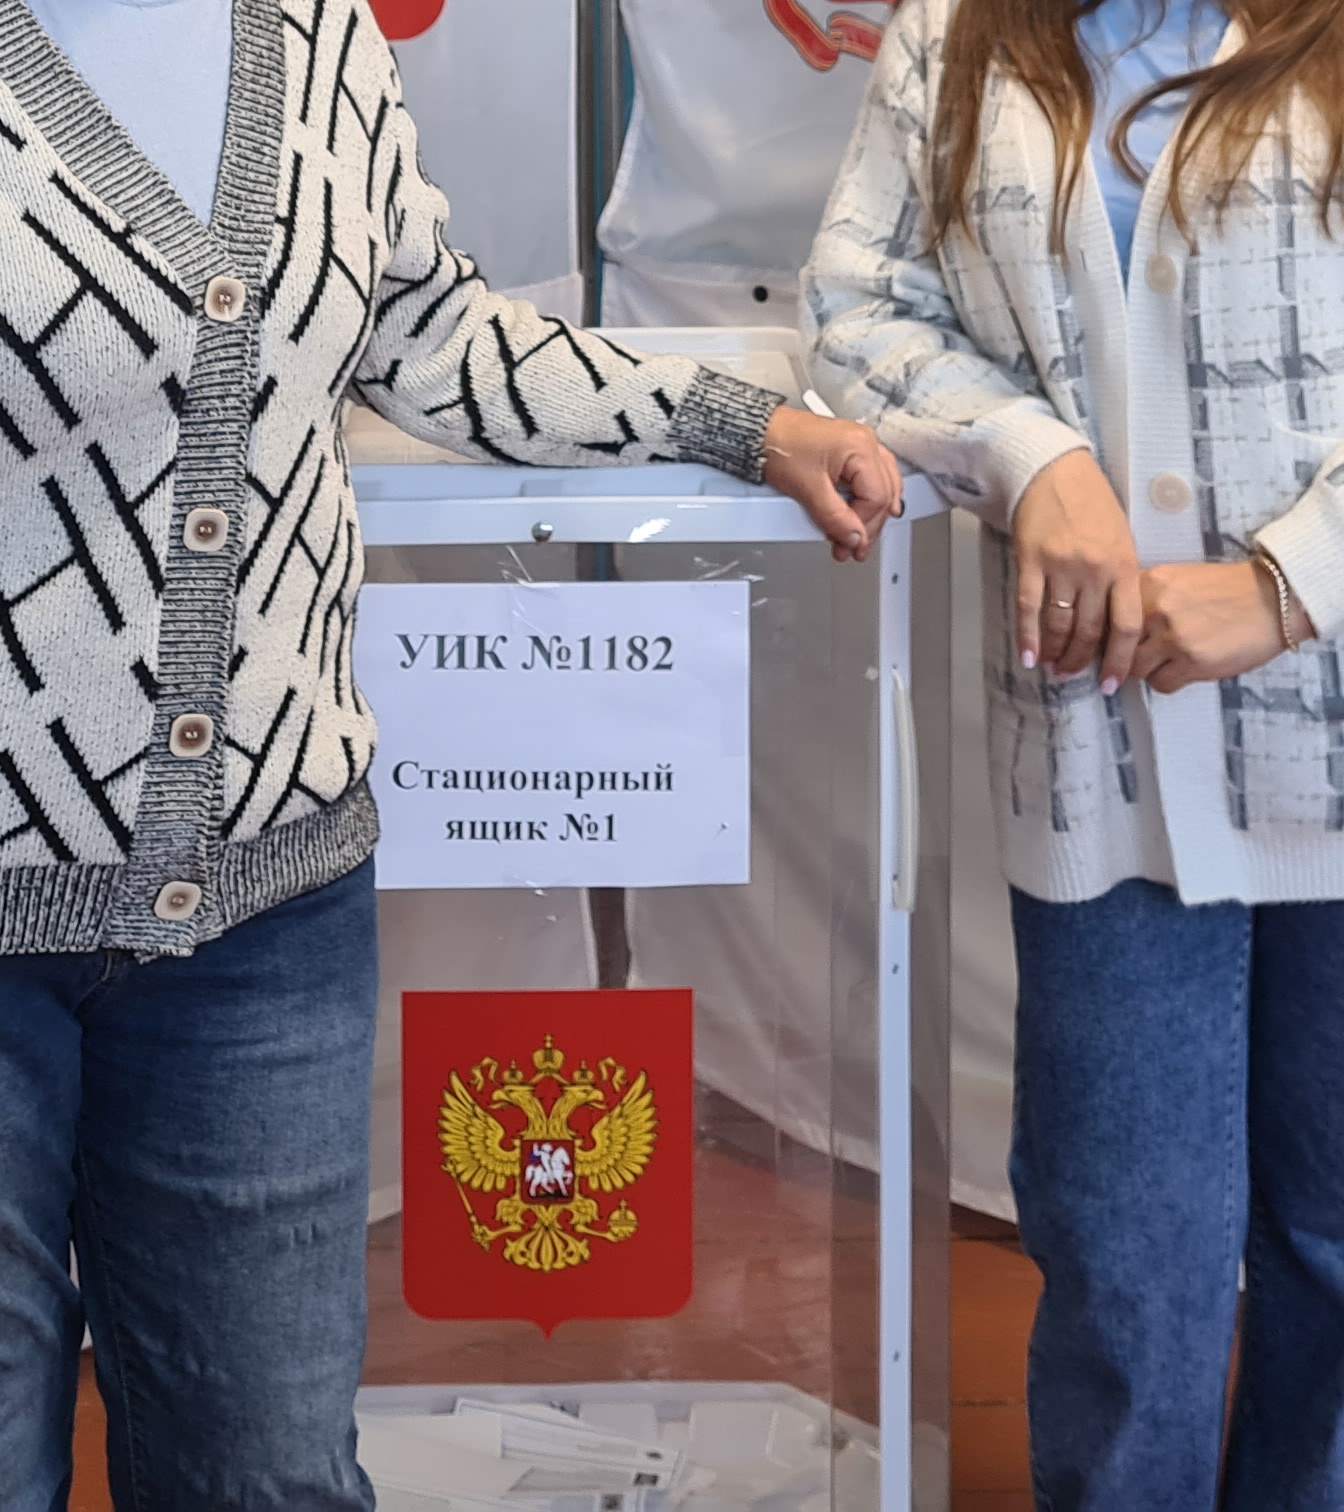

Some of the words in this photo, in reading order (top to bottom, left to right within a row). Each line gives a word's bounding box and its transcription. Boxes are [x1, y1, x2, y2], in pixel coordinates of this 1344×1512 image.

[394, 633, 508, 670] УИК
[521, 634, 674, 671] №1182
[391, 760, 675, 799] Стационарный
[445, 820, 548, 843] ящик
[559, 813, 617, 841] №1
